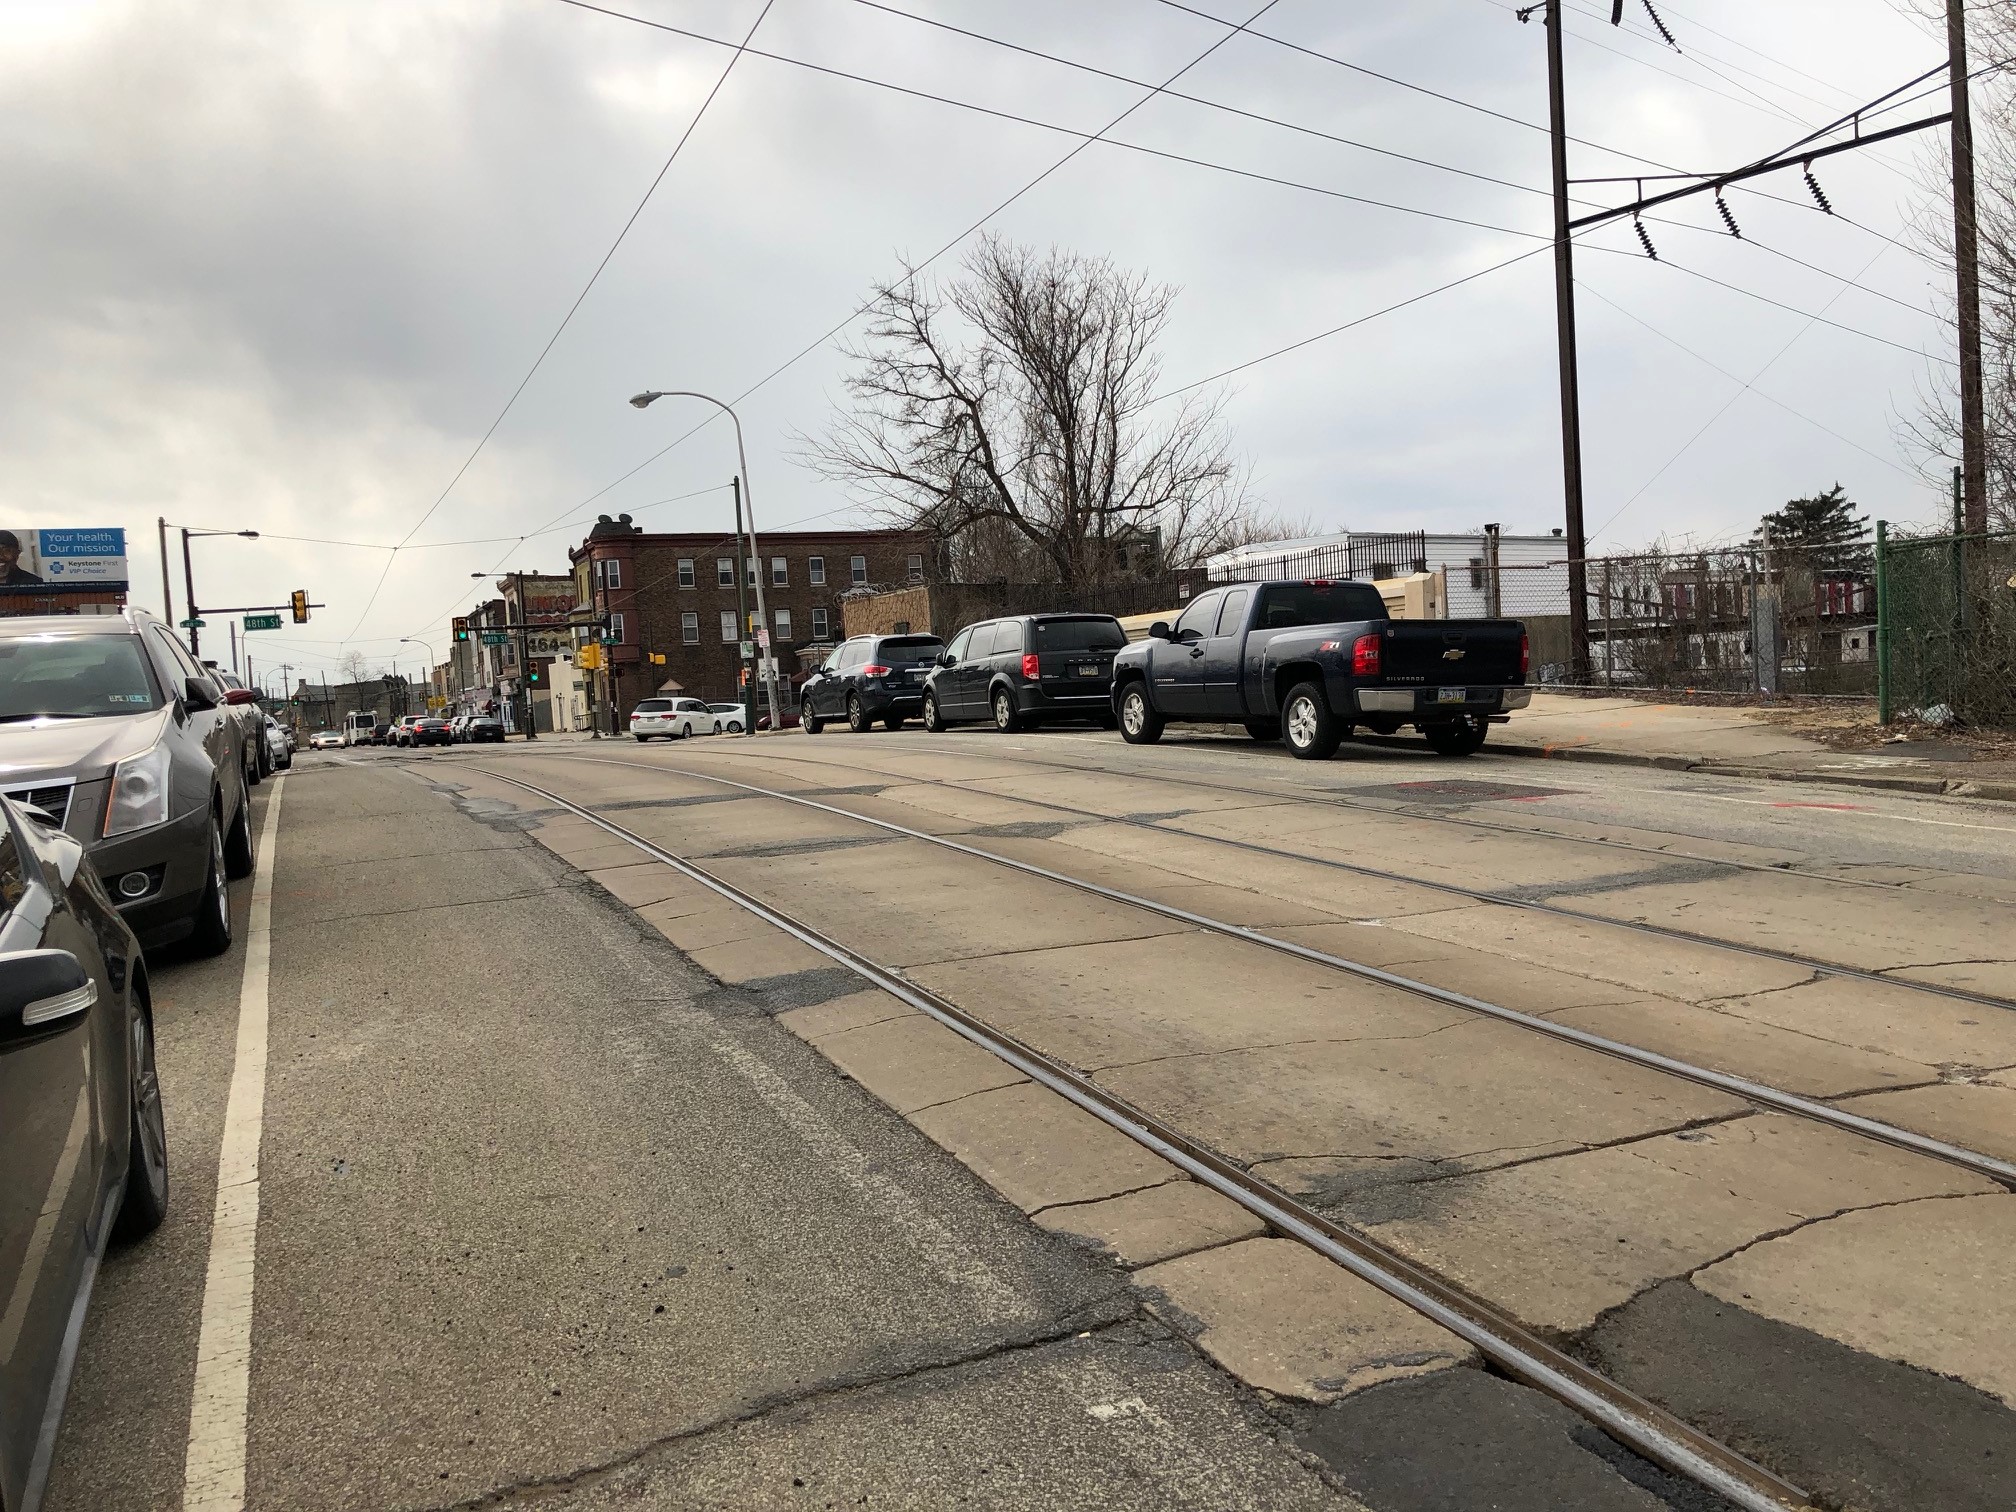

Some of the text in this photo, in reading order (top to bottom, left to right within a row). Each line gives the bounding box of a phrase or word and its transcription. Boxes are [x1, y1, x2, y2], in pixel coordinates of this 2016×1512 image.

[47, 532, 115, 542] Your health.
[48, 544, 119, 553] Our mission.
[68, 560, 101, 568] Keystone
[246, 618, 280, 628] 48th St
[484, 635, 508, 643] 48th St
